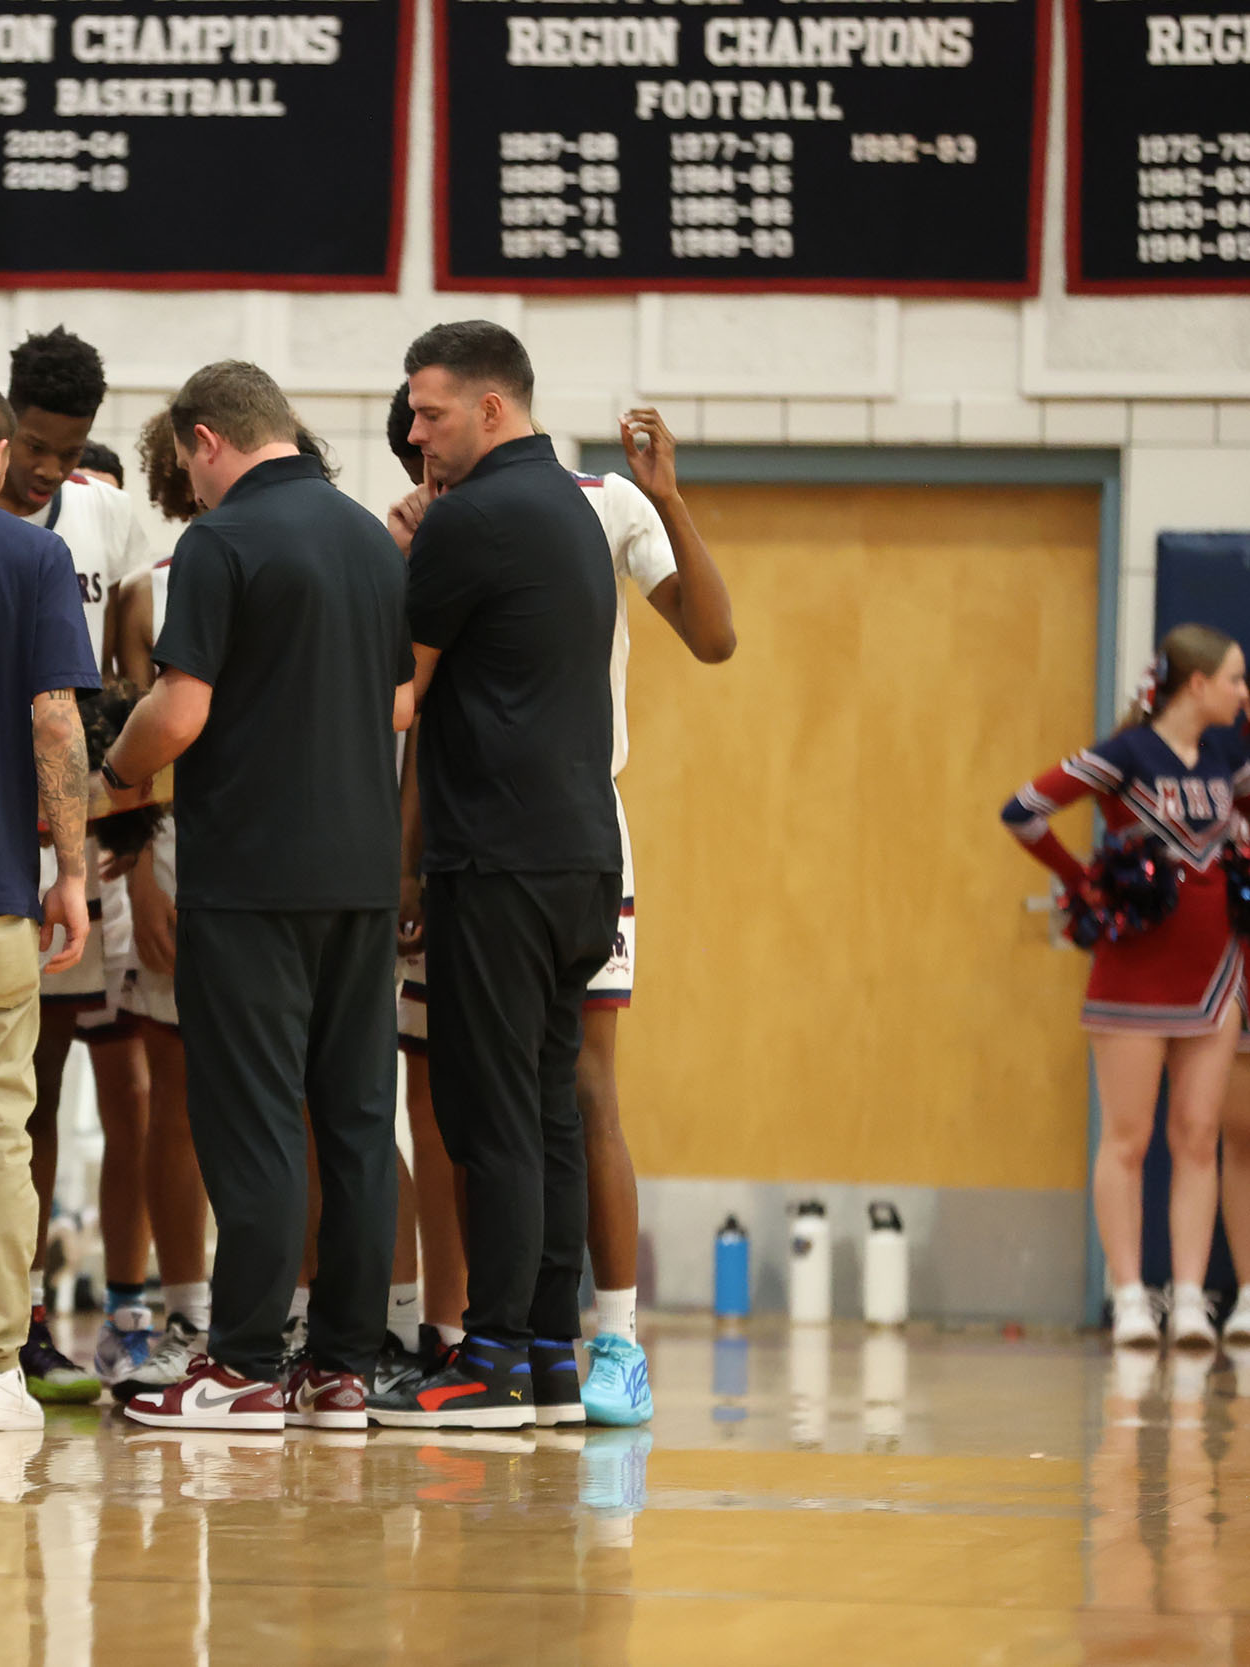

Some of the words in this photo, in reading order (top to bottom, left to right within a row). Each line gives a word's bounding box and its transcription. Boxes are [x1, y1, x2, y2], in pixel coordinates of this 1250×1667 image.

[72, 15, 341, 64] CHAMPIONS
[507, 17, 680, 66] REGION
[705, 17, 972, 67] CHAMPIONS
[56, 78, 285, 116] BASKETBALL
[636, 80, 842, 120] FOOTBALL
